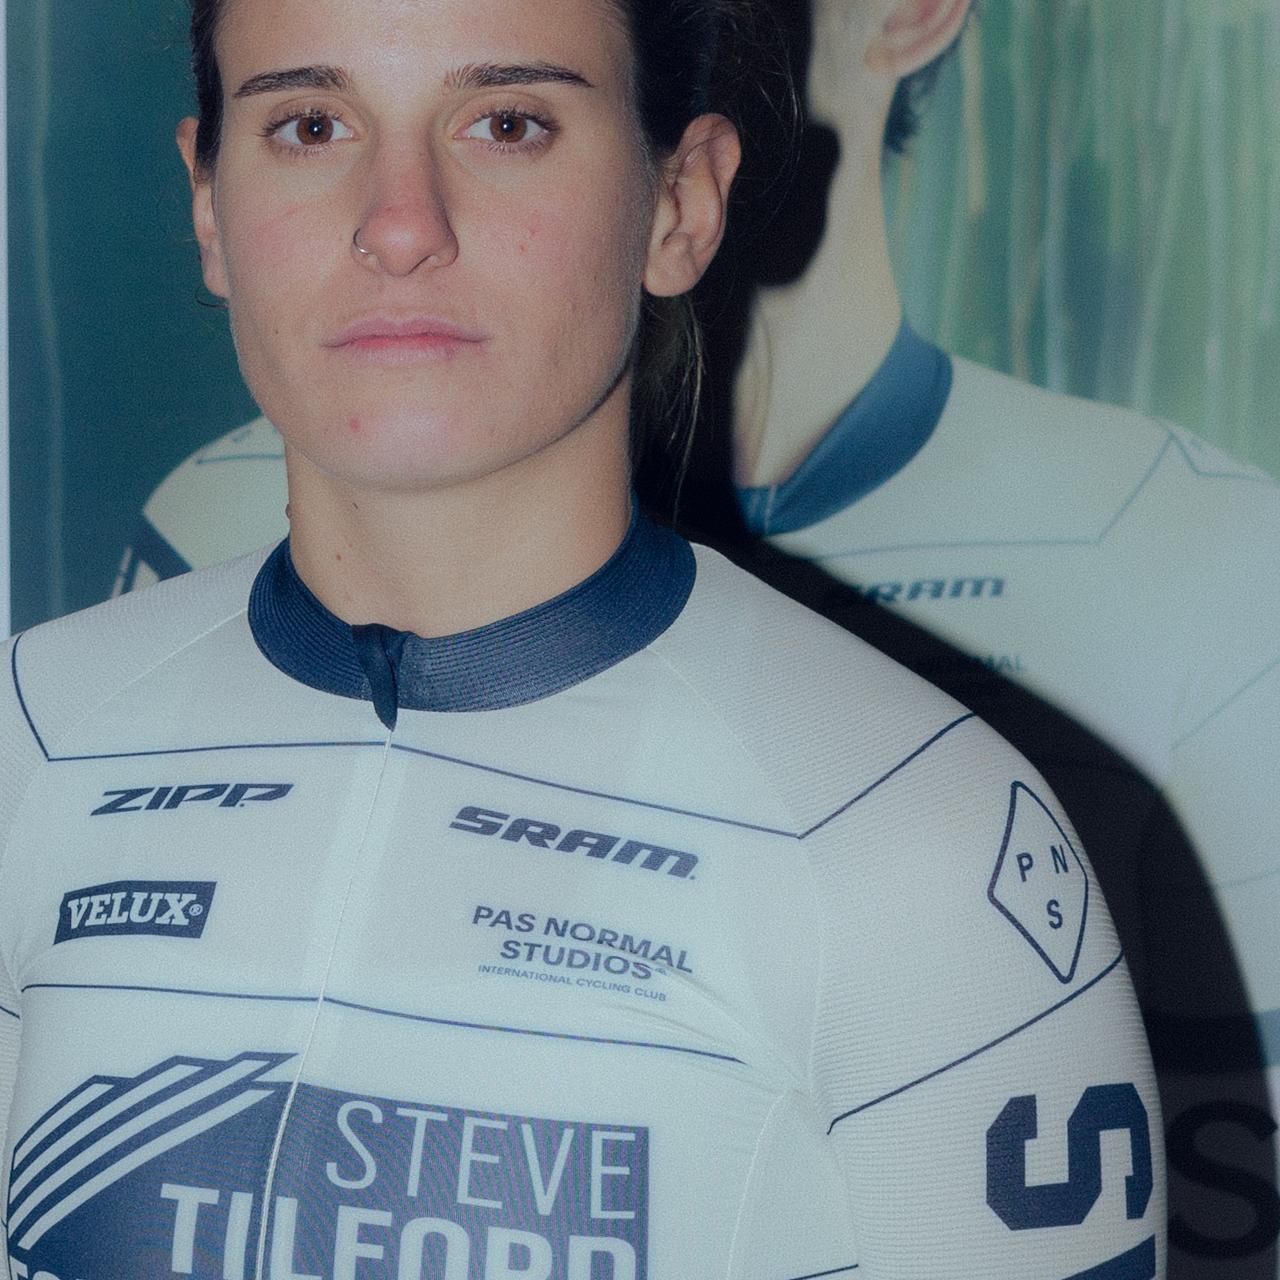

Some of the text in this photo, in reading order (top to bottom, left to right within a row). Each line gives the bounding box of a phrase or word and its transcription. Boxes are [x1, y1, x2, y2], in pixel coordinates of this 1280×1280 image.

[89, 782, 295, 817] ZIPP
[448, 805, 699, 880] SRAM
[471, 904, 694, 974] PAS NORMAL
[477, 963, 668, 1003] INTERNATIONAL CYCLING CLUB
[326, 1099, 638, 1222] STEVE
